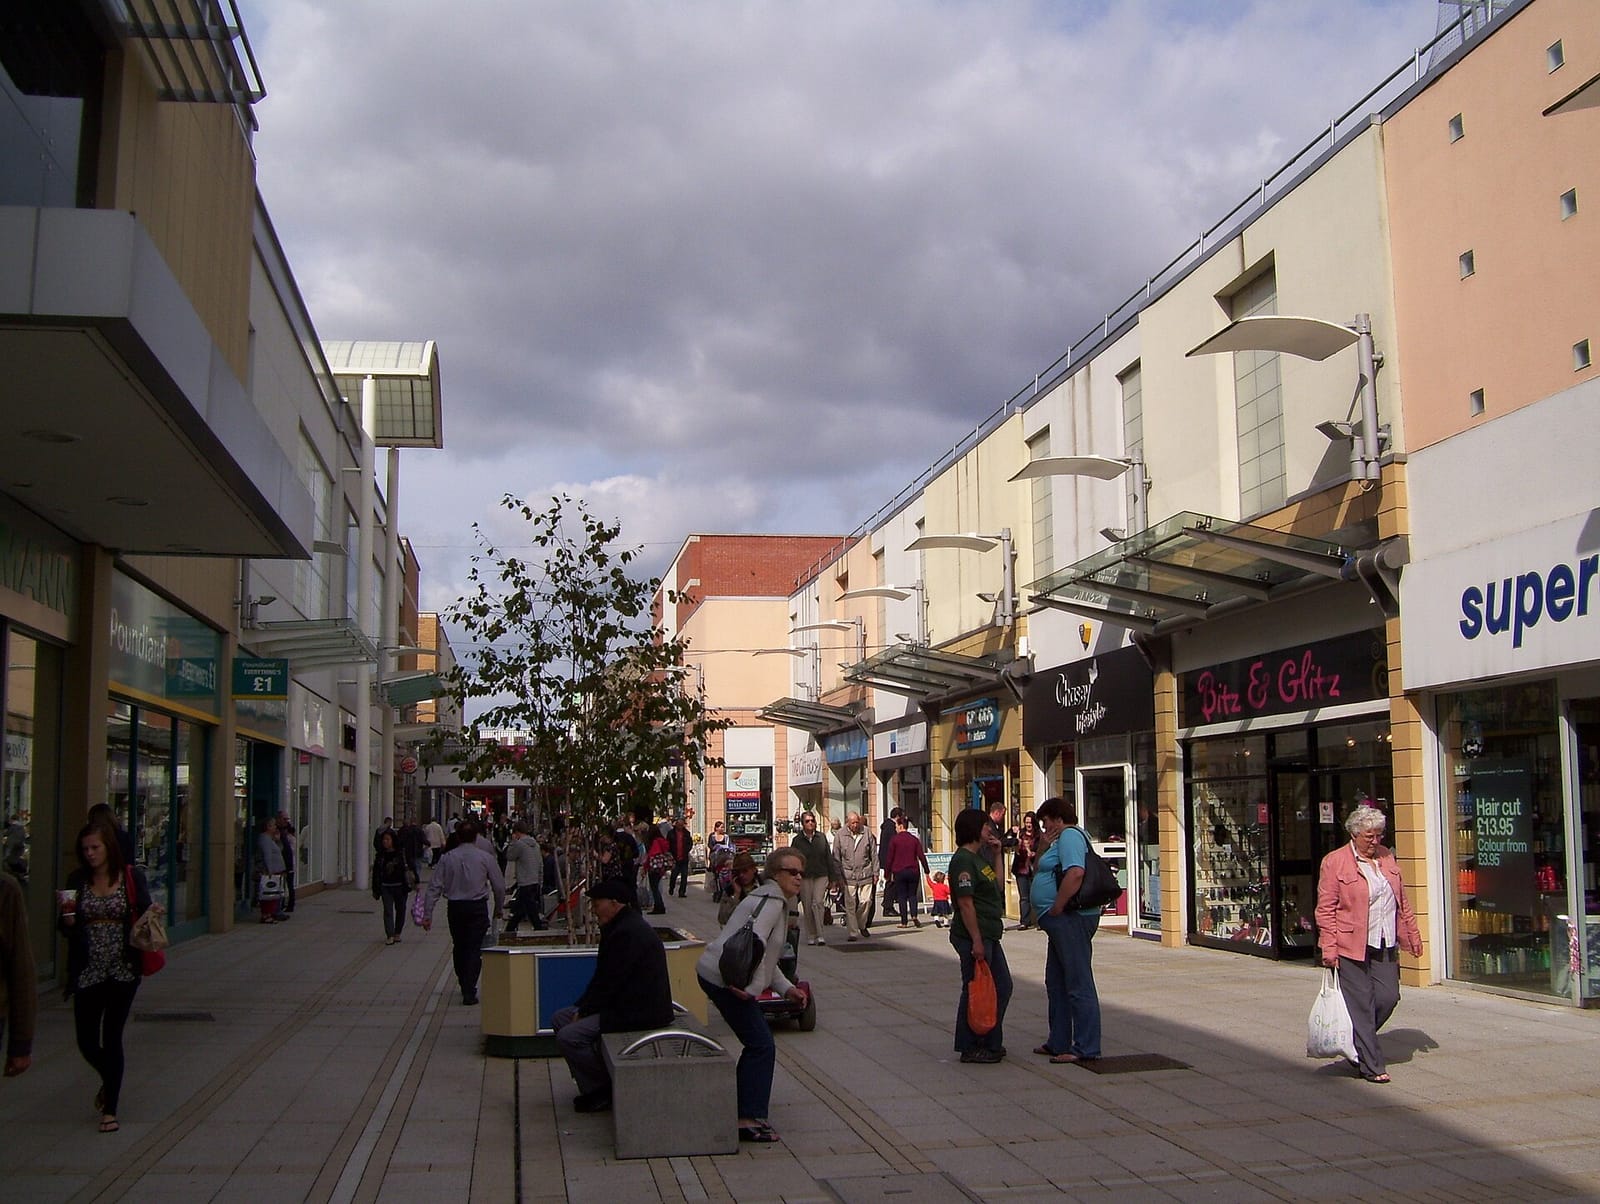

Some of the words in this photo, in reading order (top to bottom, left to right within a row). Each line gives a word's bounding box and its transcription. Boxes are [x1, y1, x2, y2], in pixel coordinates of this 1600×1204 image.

[110, 607, 166, 669] Poundland
[253, 676, 273, 692] £1
[1055, 672, 1092, 711] Chasey
[1197, 670, 1241, 722] Bitz
[1247, 660, 1270, 709] &
[1278, 649, 1341, 703] Glitz
[1475, 797, 1499, 816] Hair
[1501, 797, 1521, 816] cut
[1476, 817, 1514, 836] £13.95
[1477, 838, 1506, 853] Colour
[1506, 838, 1528, 853] from
[1478, 852, 1501, 866] £3.95
